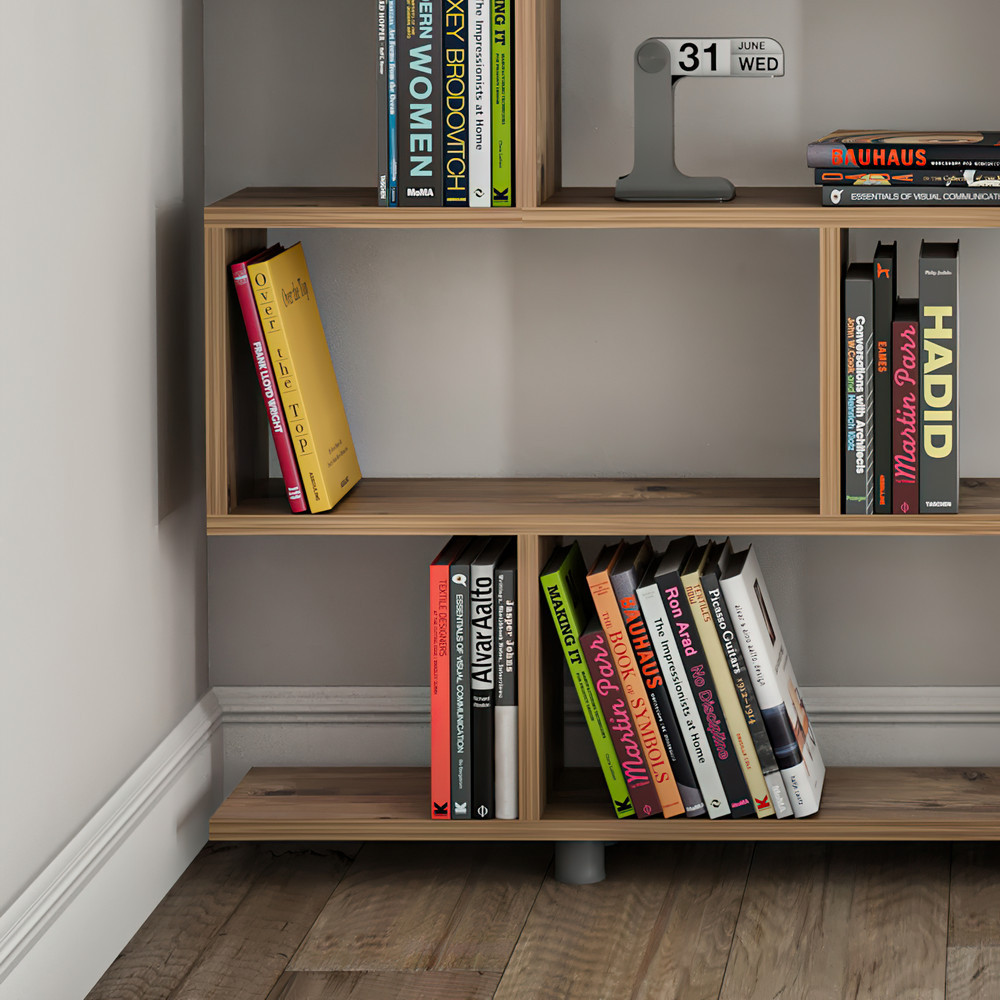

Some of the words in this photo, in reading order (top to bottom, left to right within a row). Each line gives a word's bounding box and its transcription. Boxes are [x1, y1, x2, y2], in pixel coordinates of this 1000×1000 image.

[378, 12, 386, 41] HOPPER
[494, 30, 506, 46] IT
[473, 20, 485, 101] Impressionists
[678, 42, 717, 72] 31
[738, 41, 765, 50] JUNE
[738, 57, 779, 71] WED
[409, 44, 433, 177] WOMEN
[446, 49, 466, 190] BRODOVITCH
[475, 105, 484, 115] at
[475, 119, 484, 150] Home
[831, 148, 927, 166] BAUHAUS
[406, 188, 434, 197] MoMA
[850, 192, 899, 201] ESSENTIALS
[900, 192, 912, 201] OF
[914, 191, 942, 201] VISUAL
[847, 317, 855, 338] John
[251, 341, 268, 371] FRANK
[253, 271, 280, 330] Over
[273, 347, 294, 390] the
[288, 403, 311, 453] Top
[855, 315, 866, 393] Conversations
[877, 341, 887, 373] EAMES
[893, 325, 916, 387] Parr
[259, 370, 276, 400] LLOYD
[847, 375, 856, 393] and
[923, 305, 953, 459] HADID
[266, 398, 284, 435] WRIGHT
[847, 394, 856, 429] Heinrich
[856, 395, 866, 418] with
[847, 431, 856, 451] Klotz
[856, 420, 866, 474] Architects
[894, 392, 917, 480] Martin
[439, 579, 447, 610] TEXTILE
[664, 586, 686, 619] Ron
[439, 612, 447, 656] DESIGNERS
[456, 594, 464, 642] ESSENTIALS
[504, 600, 514, 637] Jasper
[546, 584, 577, 647] MAKING
[568, 648, 583, 666] IT
[653, 617, 667, 638] The
[707, 587, 731, 631] Picasso
[721, 629, 746, 675] Guitars
[456, 643, 464, 653] OF
[619, 594, 664, 690] BAUHAUS
[675, 619, 699, 657] Arad
[456, 655, 464, 683] VISUAL
[505, 640, 514, 672] Johns
[581, 633, 621, 698] Parr
[658, 638, 694, 718] Impressionists
[689, 664, 709, 688] No
[601, 611, 613, 630] THE
[608, 630, 637, 681] BOOK
[625, 684, 634, 696] OF
[630, 696, 671, 784] SYMBOLS
[456, 684, 465, 753] COMMUNICATION
[686, 718, 697, 731] at
[695, 689, 733, 762] Discipline
[602, 697, 650, 786] Martin
[690, 732, 708, 764] Home
